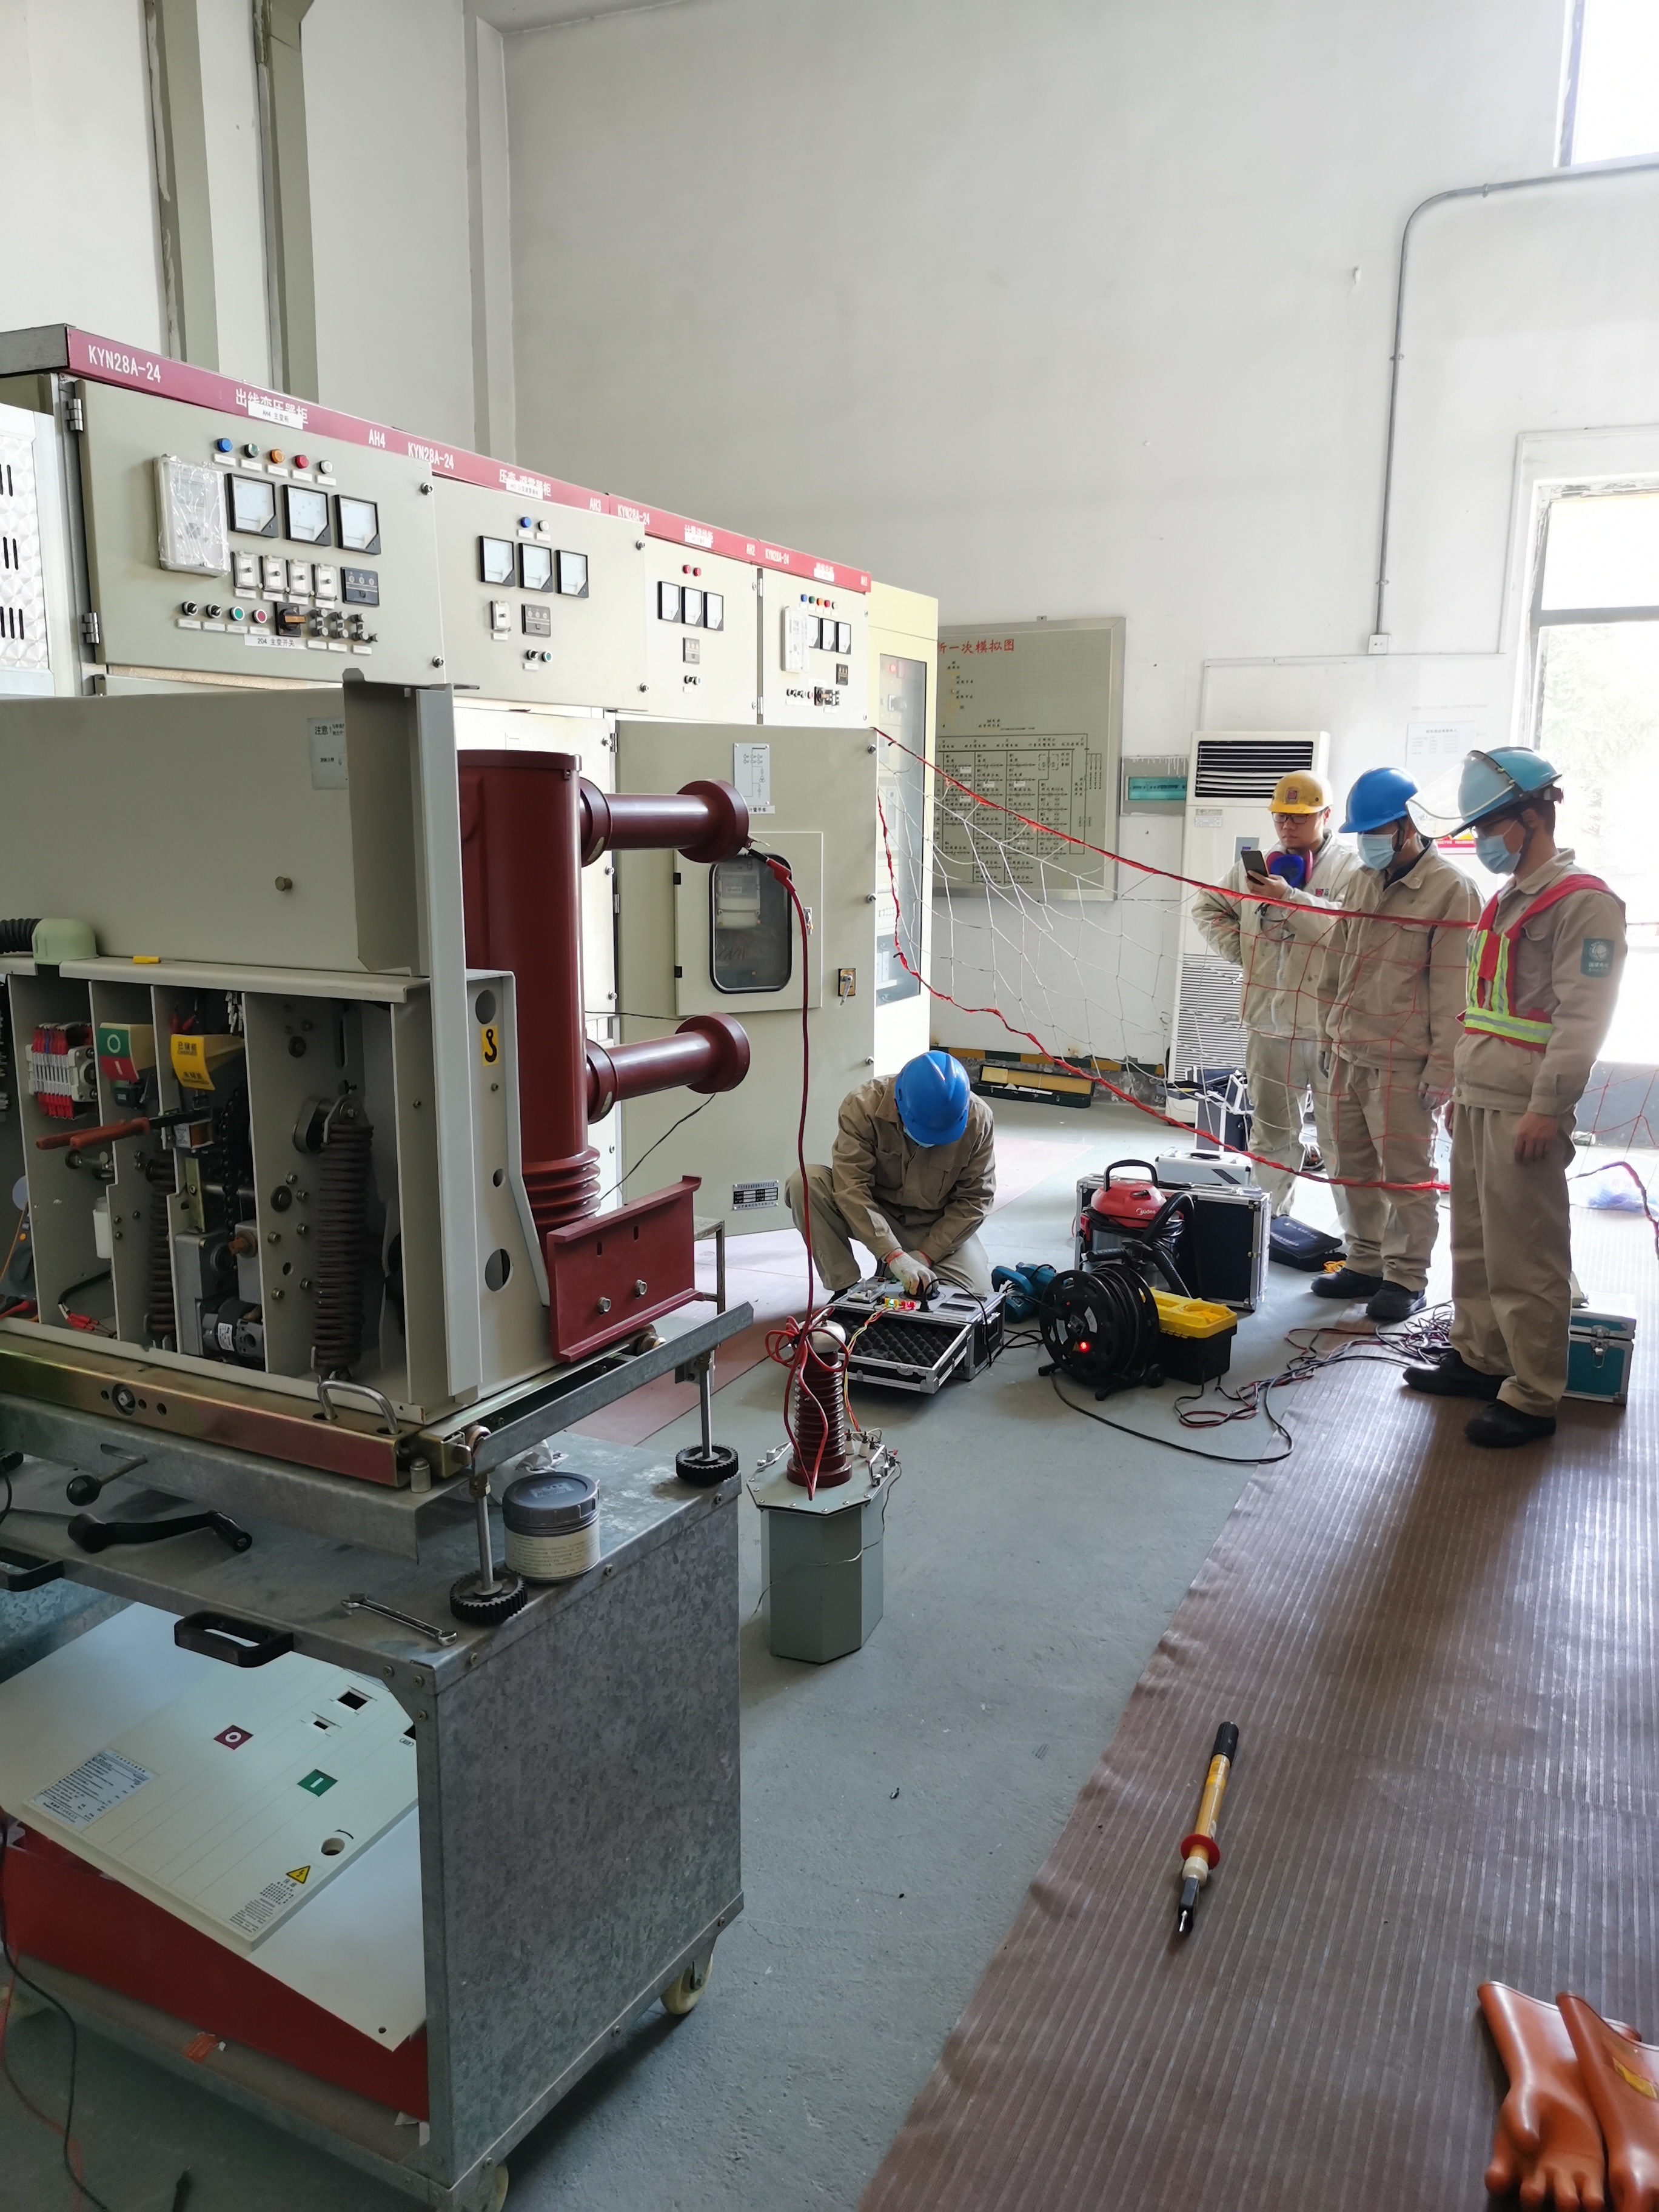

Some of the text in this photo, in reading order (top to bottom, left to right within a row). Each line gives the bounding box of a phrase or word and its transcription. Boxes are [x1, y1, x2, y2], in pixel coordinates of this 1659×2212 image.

[89, 344, 161, 383] KYN28A-24
[369, 429, 386, 447] AH4
[408, 442, 454, 469] KYN28A-24
[589, 497, 602, 512] AH3
[617, 504, 650, 525] KYN28A-24
[746, 543, 756, 556] AH2
[765, 548, 789, 565] KYN28A-24
